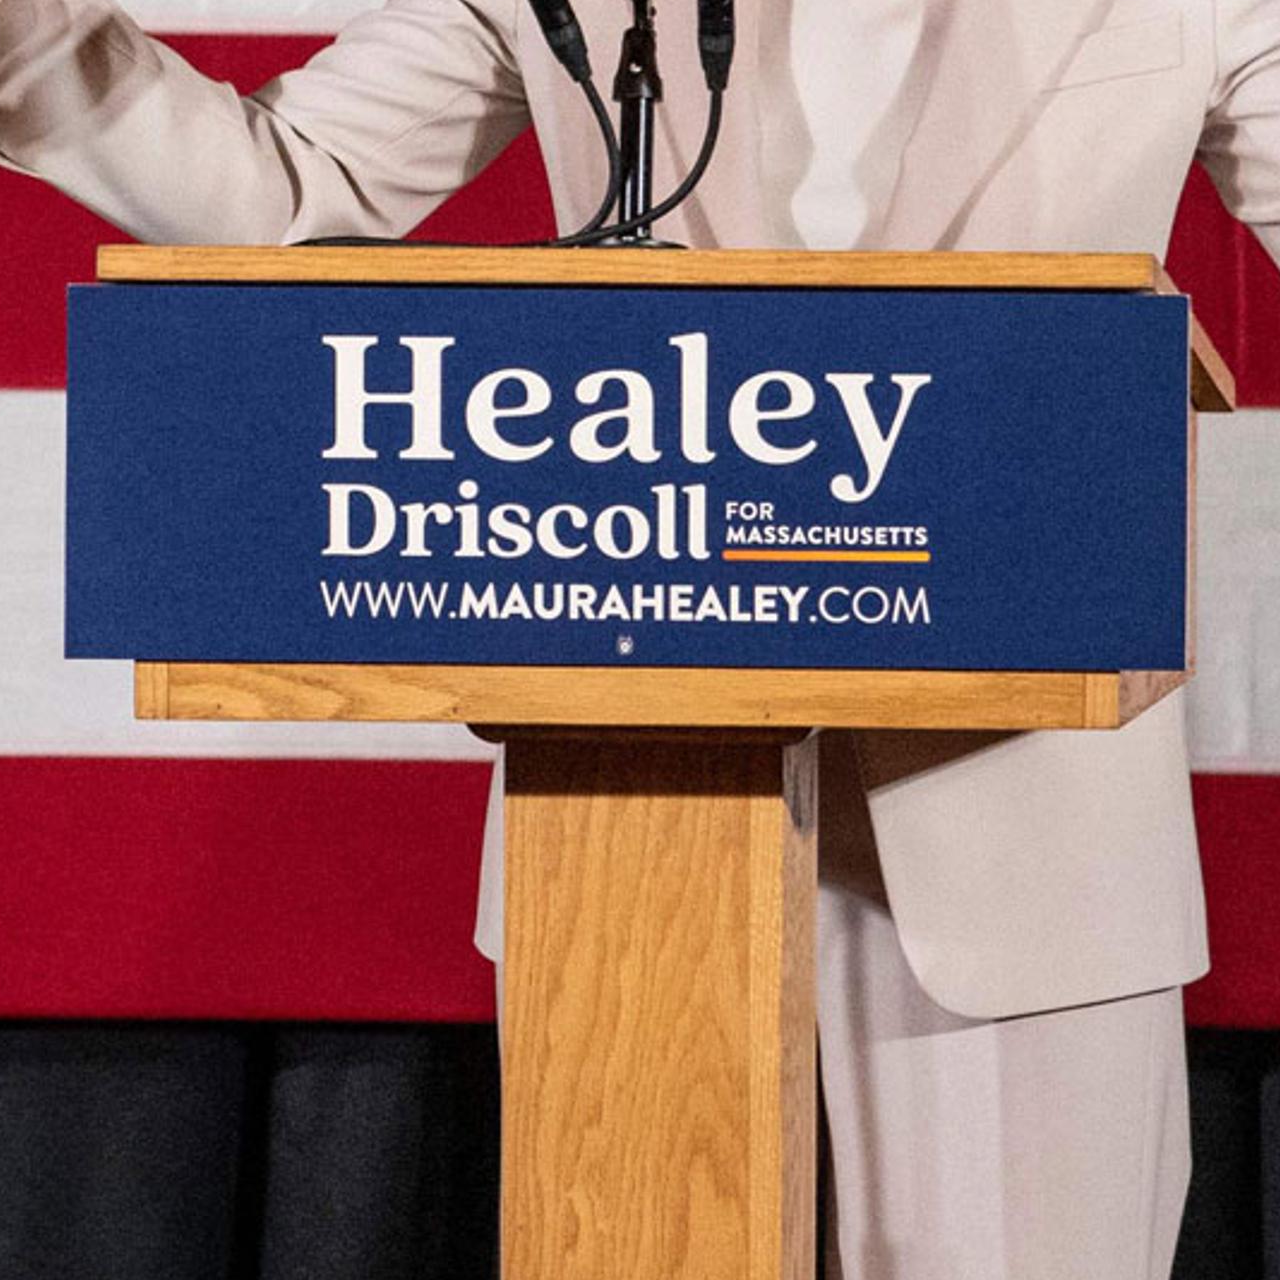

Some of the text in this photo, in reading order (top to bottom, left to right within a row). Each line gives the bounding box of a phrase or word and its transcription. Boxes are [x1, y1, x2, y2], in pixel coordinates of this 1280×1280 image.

[322, 333, 931, 503] Healey
[322, 480, 710, 559] Driscoll
[726, 501, 774, 521] FOR
[726, 525, 928, 545] MASSACHUSETTS
[321, 581, 931, 623] WWW.MAURAHEALEY.COM
